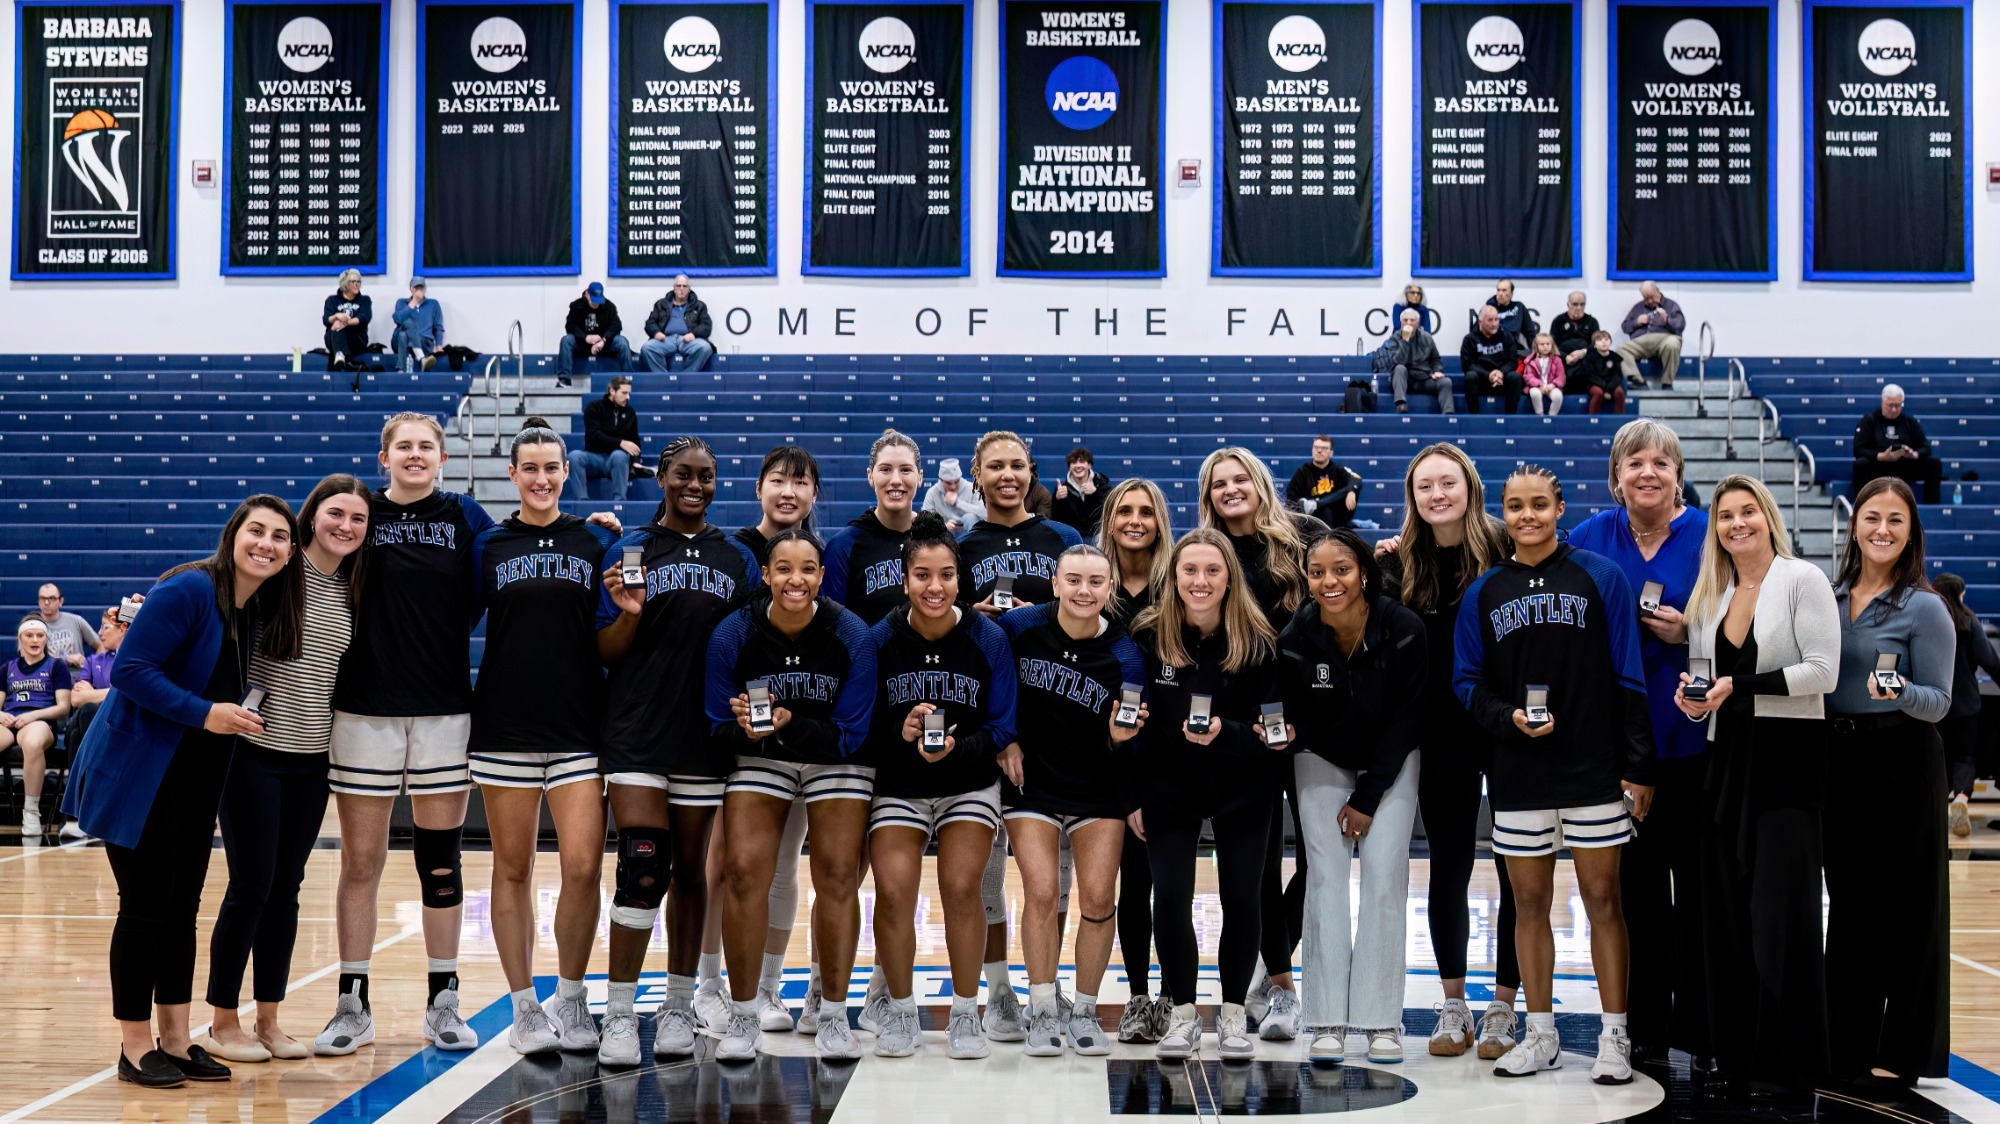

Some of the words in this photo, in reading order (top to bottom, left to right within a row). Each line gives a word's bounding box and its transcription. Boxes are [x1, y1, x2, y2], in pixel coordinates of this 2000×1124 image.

[1040, 11, 1126, 28] WOMEN'S
[42, 17, 153, 39] BARBARA
[1025, 30, 1141, 47] BASKETBALL
[45, 45, 149, 68] STEVENS
[284, 43, 330, 58] NCAA
[477, 44, 523, 58] NCAA
[671, 43, 717, 58] NCAA
[866, 43, 913, 58] NCAA
[1276, 43, 1323, 58] NCAA
[1474, 43, 1522, 58] NCAA
[1669, 45, 1717, 60] NCAA
[1865, 45, 1913, 60] NCAA
[56, 88, 138, 98] WOMEN'S
[258, 78, 352, 96] WOMEN'S
[451, 78, 547, 96] WOMEN'S
[644, 78, 742, 96] WOMEN'S
[839, 79, 935, 97] WOMEN'S
[1266, 78, 1330, 96] MEN'S
[1464, 78, 1528, 96] MEN'S
[1644, 81, 1742, 99] WOMEN'S
[1839, 81, 1937, 100] WOMEN'S
[56, 98, 138, 106] BASKETBALL
[244, 96, 366, 113] BASKETBALL
[437, 96, 561, 114] BASKETBALL
[631, 96, 755, 114] BASKETBALL
[825, 97, 950, 114] BASKETBALL
[1052, 91, 1116, 112] NCAA
[1235, 96, 1362, 113] BASKETBALL
[1433, 96, 1560, 113] BASKETBALL
[1631, 100, 1755, 117] VOLLEYBALL
[1826, 99, 1950, 117] VOLLEYBALL
[628, 125, 655, 137] FINAL
[656, 125, 681, 137] FOUR
[824, 128, 850, 139] FINAL
[851, 128, 876, 139] FOUR
[1431, 127, 1457, 139] ELITE
[1458, 127, 1486, 139] EIGHT
[1825, 130, 1850, 142] ELITE
[1851, 130, 1879, 142] EIGHT
[629, 139, 670, 151] NATIONAL
[672, 139, 722, 151] RUNNER-UP
[823, 143, 849, 154] ELITE
[850, 143, 877, 154] EIGHT
[1431, 143, 1459, 154] FINAL
[1460, 143, 1485, 154] FOUR
[1825, 145, 1852, 157] FINAL
[1853, 146, 1878, 157] FOUR
[629, 154, 655, 166] FINAL
[656, 154, 681, 166] FOUR
[1033, 145, 1113, 163] DIVISION
[1116, 145, 1132, 163] II
[824, 158, 850, 169] FINAL
[851, 158, 876, 170] FOUR
[1431, 158, 1459, 169] FINAL
[1460, 158, 1485, 169] FOUR
[628, 170, 655, 181] FINAL
[656, 170, 681, 181] FOUR
[823, 173, 865, 185] NATIONAL
[866, 173, 917, 185] CHAMPIONS
[1018, 164, 1147, 187] NATIONAL
[1431, 173, 1457, 185] ELITE
[1458, 173, 1486, 185] EIGHT
[628, 185, 655, 196] FINAL
[656, 185, 681, 196] FOUR
[823, 188, 850, 200] FINAL
[851, 189, 875, 200] FOUR
[628, 200, 654, 211] ELITE
[655, 200, 682, 211] EIGHT
[823, 203, 848, 215] ELITE
[849, 204, 876, 215] EIGHT
[1010, 190, 1154, 213] CHAMPIONS
[54, 219, 87, 230] HALL
[100, 219, 136, 230] FAME
[628, 215, 655, 226] FINAL
[656, 215, 681, 226] FOUR
[628, 230, 654, 241] ELITE
[655, 229, 682, 241] EIGHT
[1049, 230, 1115, 255] 2014
[38, 248, 86, 264] CLASS
[88, 248, 108, 264] OF
[110, 248, 149, 264] 2006
[628, 244, 654, 256] ELITE
[655, 244, 682, 256] EIGHT
[725, 307, 856, 336] OME
[915, 307, 988, 336] OF
[1047, 307, 1167, 336] THE
[375, 521, 456, 550] ENTLEY
[496, 552, 593, 591] BENTLEY
[646, 563, 736, 602] BENTLEY
[1490, 593, 1588, 643] BENTLEY
[1165, 665, 1173, 677] B
[1320, 668, 1328, 679] B
[887, 670, 980, 708] BENTLEY
[1019, 657, 1109, 714] BENTLEY
